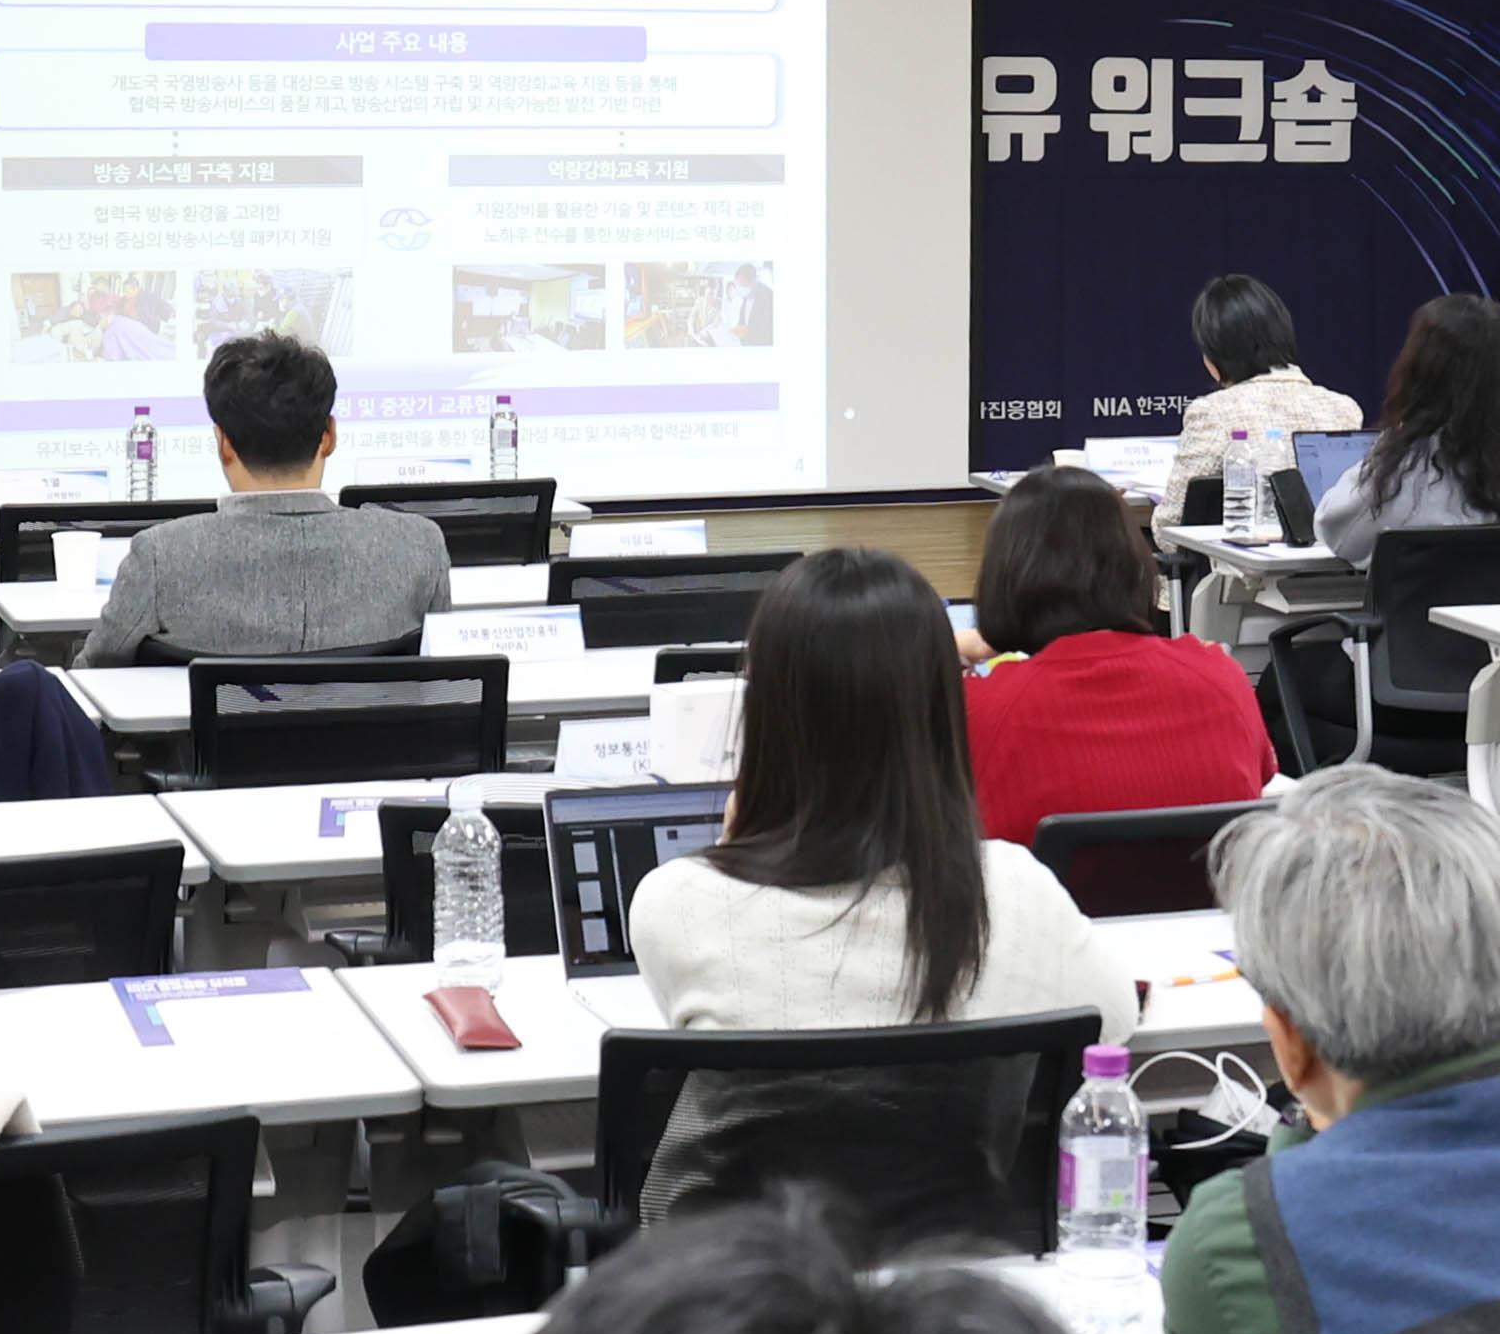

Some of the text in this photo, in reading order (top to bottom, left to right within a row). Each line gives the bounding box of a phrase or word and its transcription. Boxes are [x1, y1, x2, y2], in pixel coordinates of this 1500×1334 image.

[336, 31, 469, 54] 사업 주요 내용
[1089, 58, 1358, 162] 워크숍
[93, 162, 275, 182] 방송 시스템 구축 지원
[548, 160, 690, 179] 역량강화교육 지원
[357, 396, 375, 416] 및
[438, 395, 498, 414] 교류협
[1093, 397, 1133, 417] NIA
[594, 739, 651, 759] 정보통신
